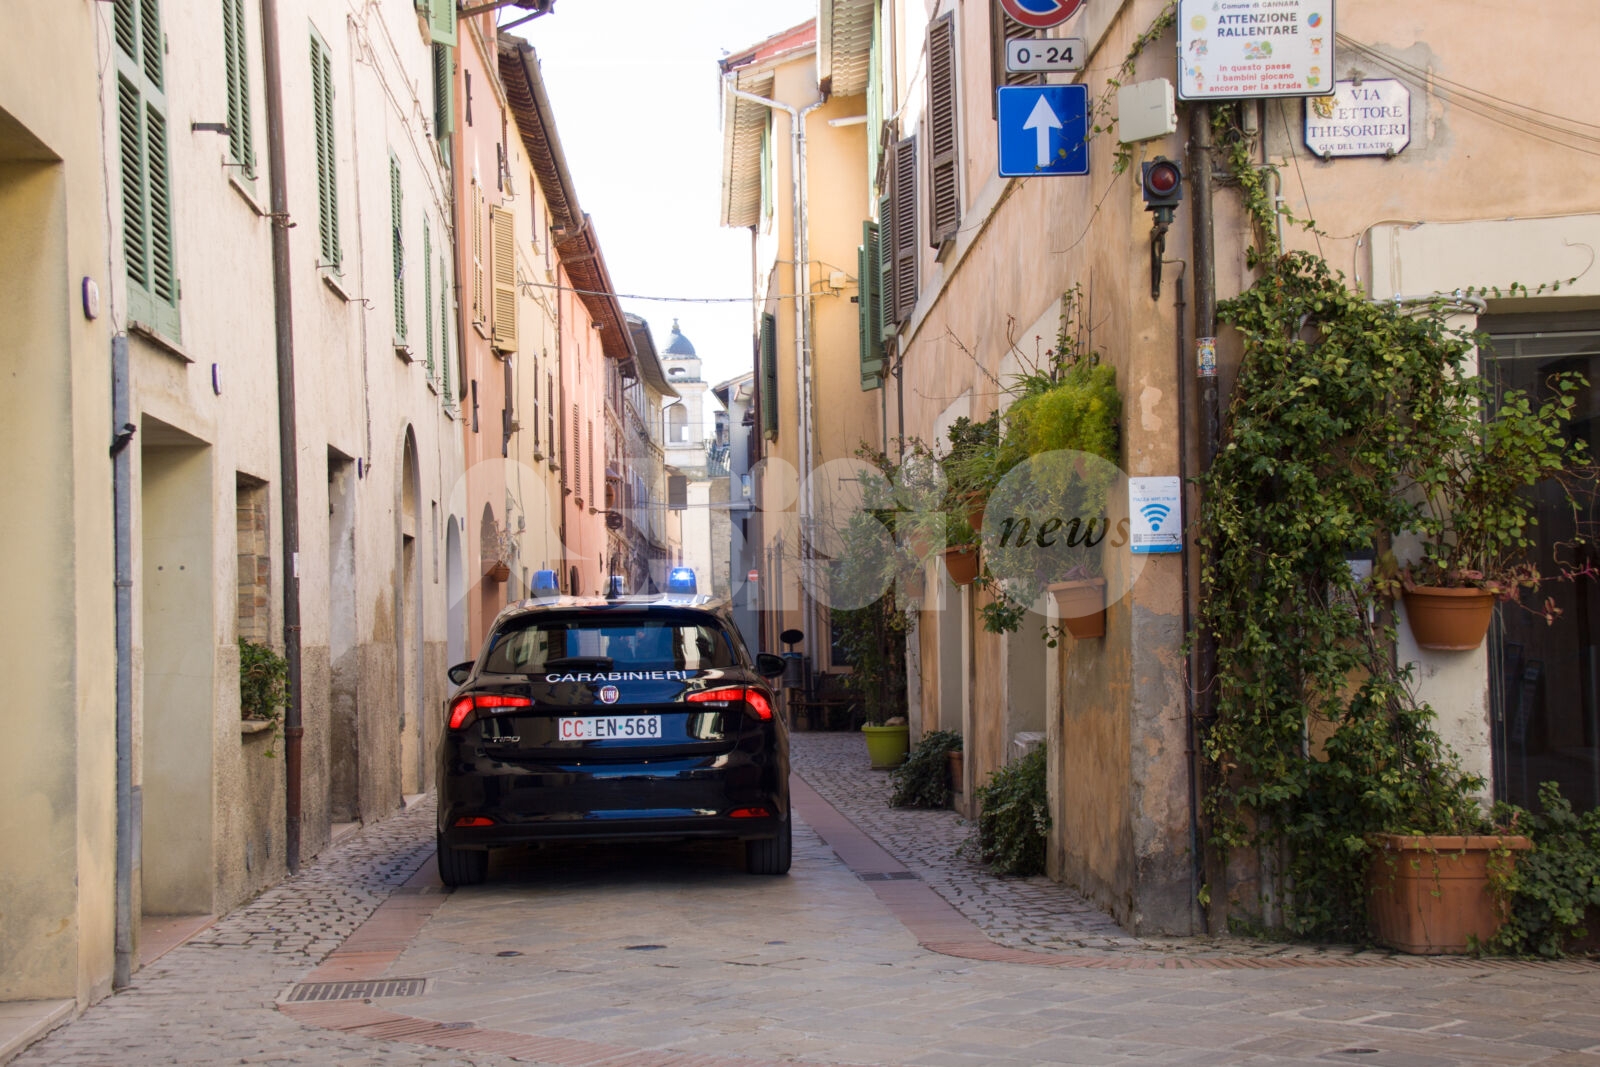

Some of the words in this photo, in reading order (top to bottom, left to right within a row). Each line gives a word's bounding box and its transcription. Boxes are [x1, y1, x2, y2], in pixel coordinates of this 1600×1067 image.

[1262, 0, 1299, 8] CANNARA
[1218, 12, 1297, 25] ATTENZIONE
[1217, 25, 1298, 37] RALLENTARE
[1046, 47, 1074, 63] 24
[1231, 64, 1261, 72] questo
[1260, 73, 1294, 81] giocano
[1242, 84, 1257, 92] per
[1351, 89, 1381, 100] VIA
[1338, 106, 1402, 119] ETTORE
[1308, 124, 1406, 137] THESORIERI
[1358, 141, 1393, 149] TEATRO
[545, 670, 687, 683] CARABINIERI
[603, 690, 616, 700] FIAT
[563, 720, 584, 738] CC
